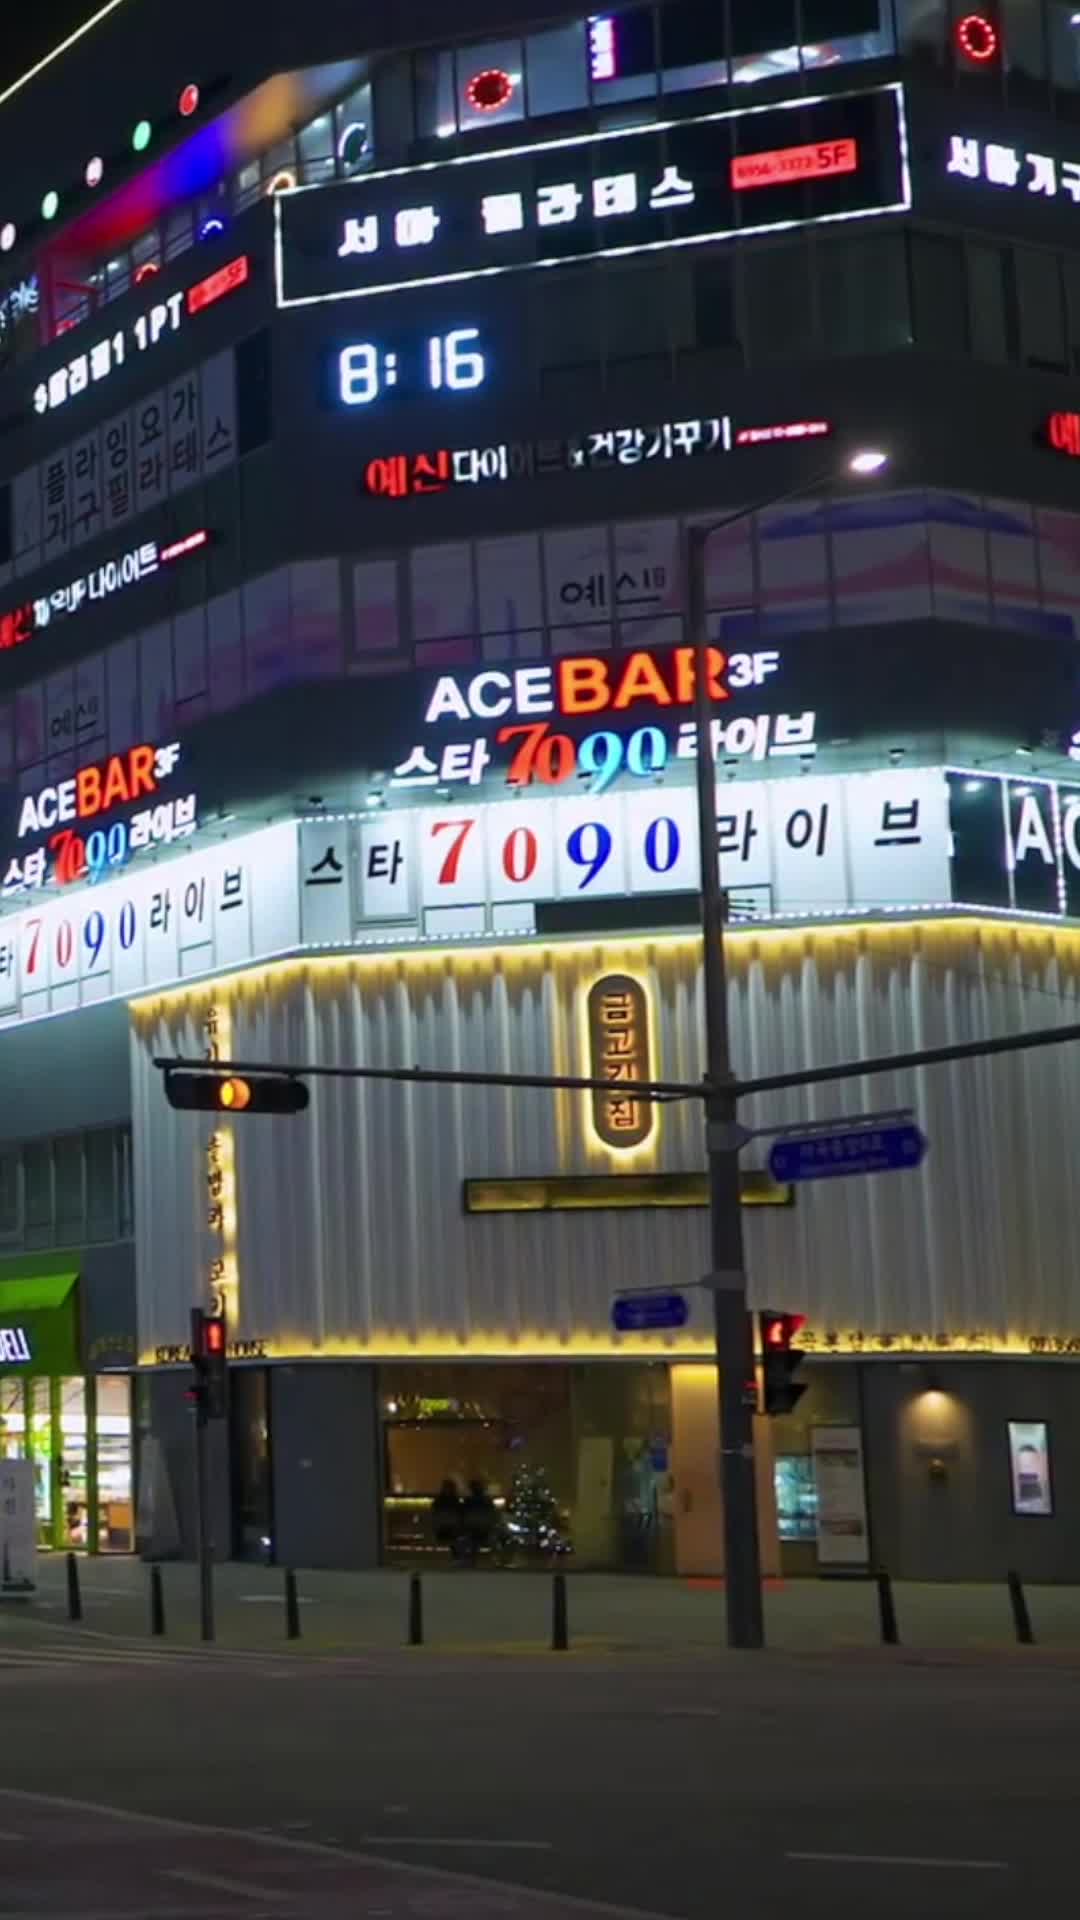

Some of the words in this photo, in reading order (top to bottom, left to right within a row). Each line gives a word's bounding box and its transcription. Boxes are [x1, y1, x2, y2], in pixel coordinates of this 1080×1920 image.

[817, 143, 849, 169] 5F
[46, 380, 197, 506] 플라잉요가
[46, 416, 233, 544] 기구필라테스
[389, 738, 490, 787] 스타
[497, 722, 667, 794] 7090
[677, 711, 818, 761] 라이브
[1, 847, 47, 896] 스타
[51, 822, 127, 886] 7090
[129, 793, 197, 849] 라이브
[305, 838, 404, 887] 스타
[430, 815, 681, 890] 7090
[26, 900, 137, 974] 7090
[150, 866, 243, 934] 라이브
